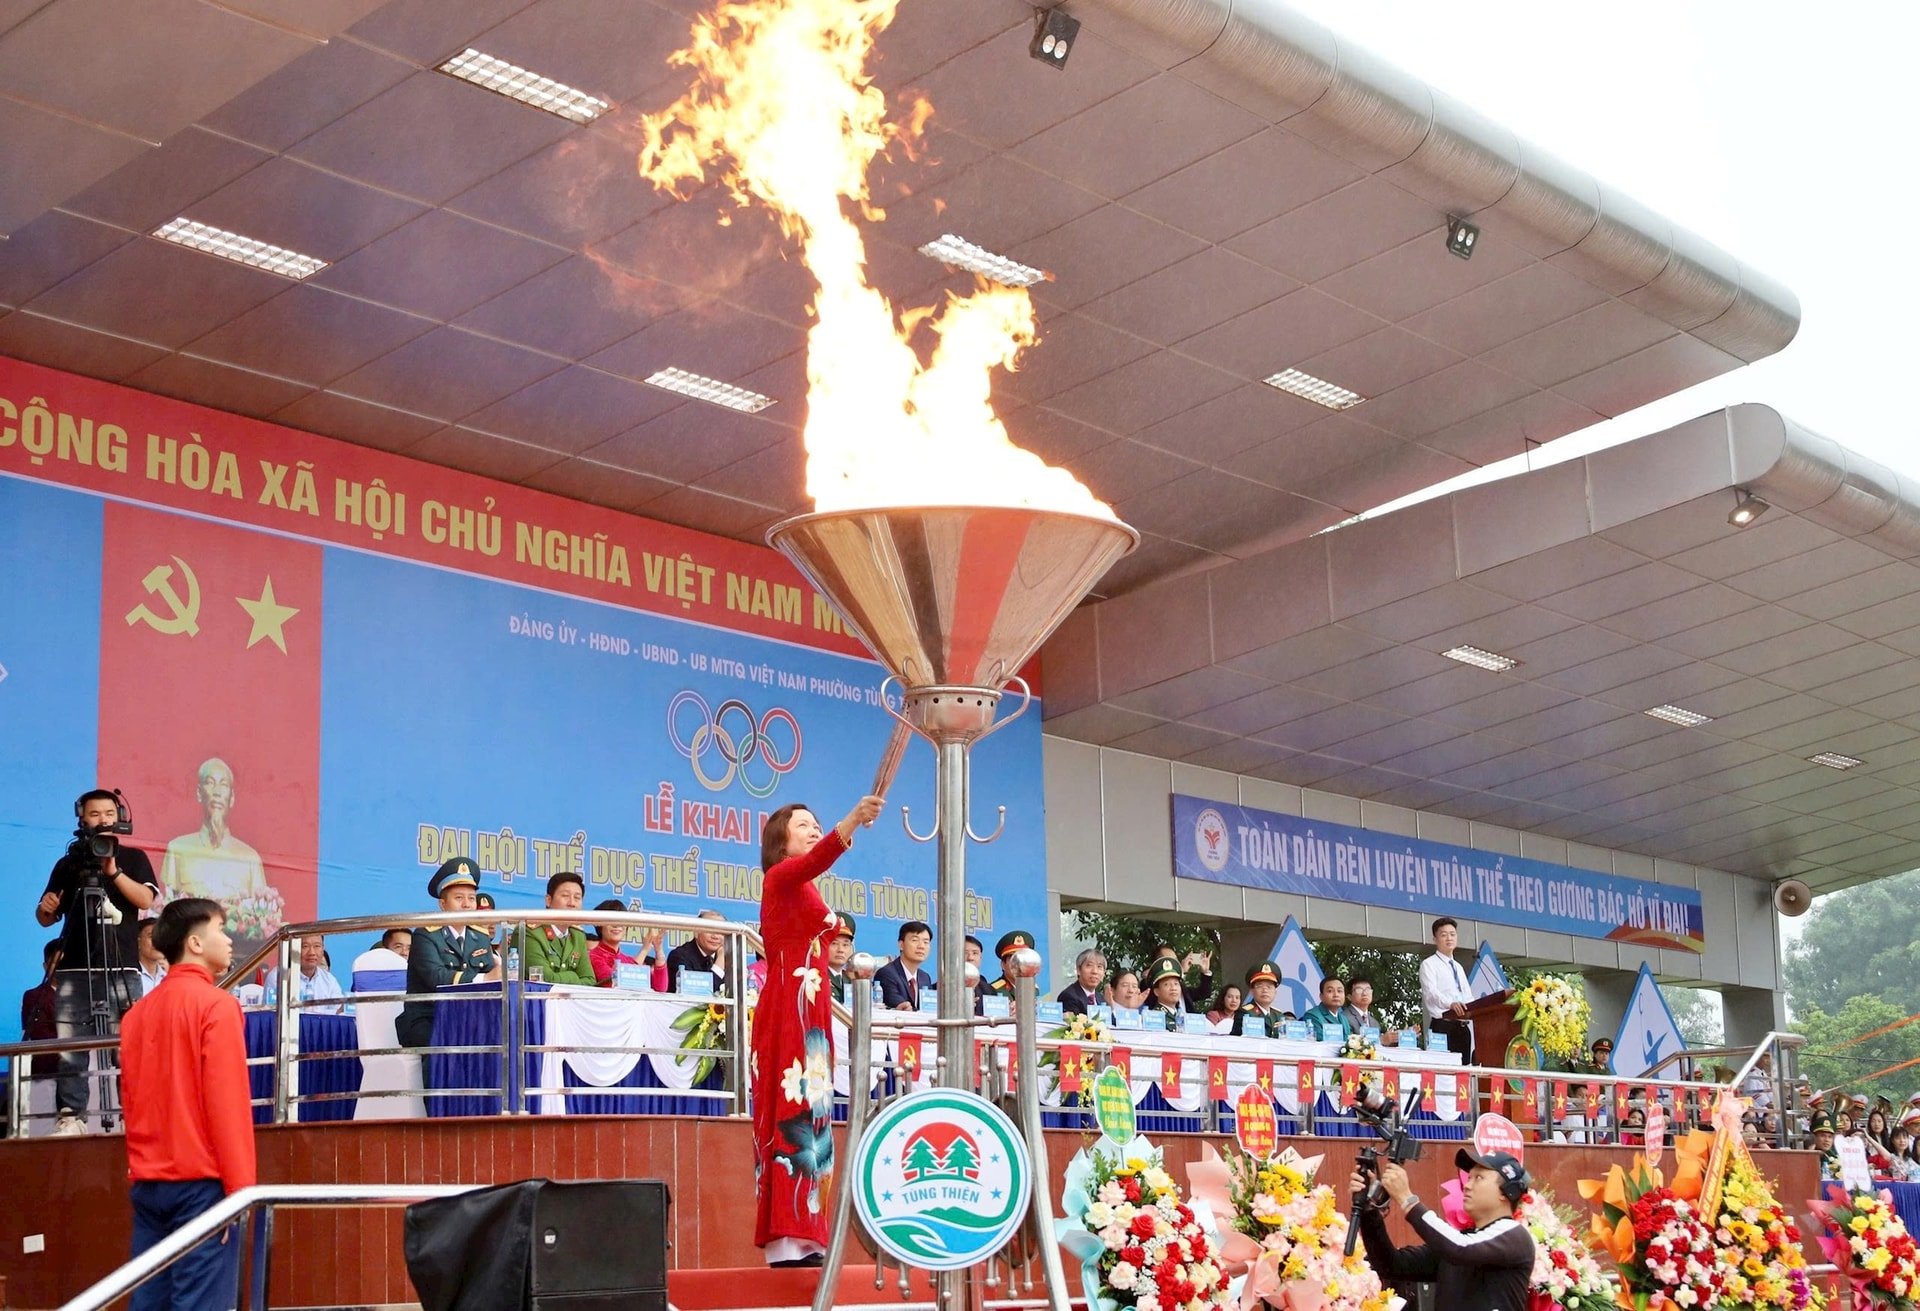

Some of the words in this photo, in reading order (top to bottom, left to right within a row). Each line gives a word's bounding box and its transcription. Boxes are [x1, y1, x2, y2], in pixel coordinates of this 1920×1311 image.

[146, 432, 244, 499] HÒA
[258, 460, 320, 516] XÃ
[335, 478, 406, 541] HỘI
[421, 496, 502, 557] CHỦ
[516, 521, 632, 588] NGHĨA
[642, 552, 716, 609] VIỆT
[726, 572, 802, 625] NAM
[509, 612, 555, 641] ĐẢNG
[558, 619, 578, 646] ỦY
[589, 632, 631, 656] HĐND
[642, 643, 679, 666] UBND
[690, 652, 708, 672] UB
[711, 656, 747, 680] MTTQ
[749, 664, 775, 689] VIỆT
[778, 671, 808, 692] NAM
[810, 678, 862, 703] PHƯỜNG
[644, 781, 674, 834] LỄ
[682, 800, 751, 844] KHAI
[477, 827, 527, 883] HỘI
[533, 830, 587, 881] THỂ
[590, 846, 646, 895] DỤC
[650, 845, 699, 897] THỂ
[703, 861, 764, 903] THAO
[870, 876, 929, 924] TÙNG
[1238, 821, 1288, 873] TOÀN
[1293, 829, 1331, 880] DÂN
[1335, 836, 1371, 886] RÈN
[1375, 847, 1428, 902] LUYỆN
[1430, 855, 1473, 902] THÂN
[1476, 857, 1505, 908] THỂ
[1507, 873, 1545, 914] THEO
[1548, 879, 1595, 921] GƯƠNG
[1597, 883, 1625, 926] BÁC
[1627, 885, 1646, 930] HỒ
[1647, 892, 1661, 931] VĨ
[1663, 901, 1690, 942] ĐẠI!
[901, 1186, 937, 1205] TÙNG
[941, 1186, 980, 1204] THIỆN
